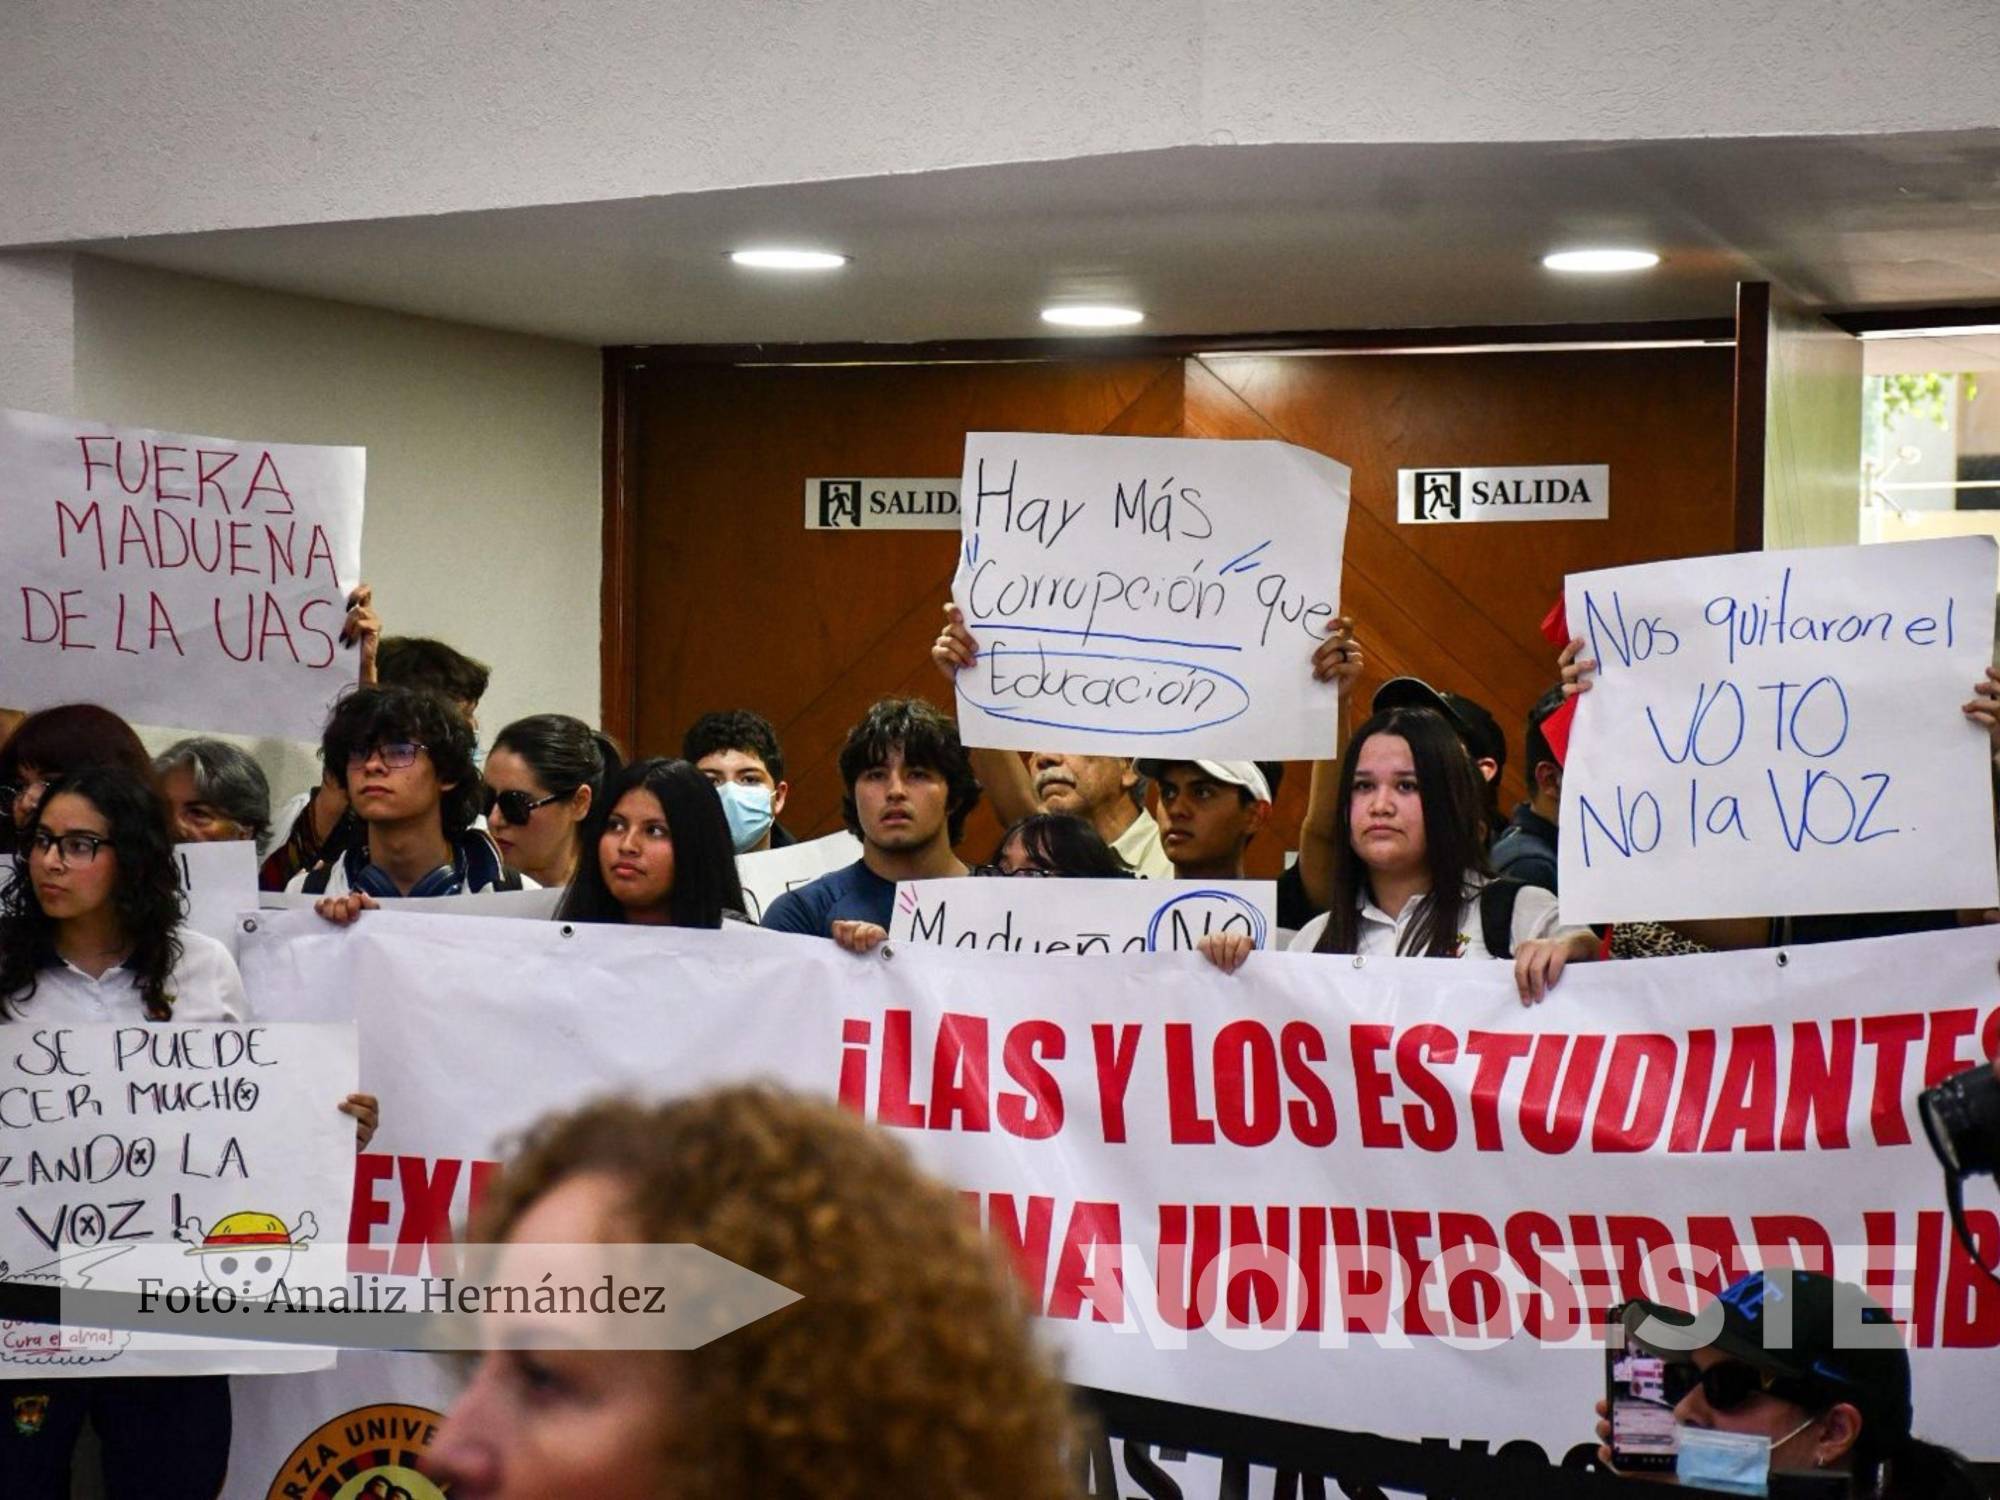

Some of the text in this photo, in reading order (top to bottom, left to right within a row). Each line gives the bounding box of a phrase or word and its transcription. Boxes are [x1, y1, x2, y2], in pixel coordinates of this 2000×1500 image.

[76, 436, 294, 514] FUERA
[974, 457, 1214, 549] Hay Más
[1471, 477, 1593, 506] SALIDA
[21, 586, 335, 668] DE LA UAS
[1256, 573, 1333, 647] que
[1583, 567, 1954, 675] Nos quitaron el
[990, 640, 1216, 713] Educación
[1645, 674, 1850, 767] VOTO
[1579, 785, 1662, 868] NO
[1690, 778, 1752, 848] la
[14, 1026, 278, 1076] SE PUEDE
[1091, 1023, 1143, 1144] Y
[1164, 1019, 1338, 1148] LOS
[1350, 1006, 2000, 1156] ESTUDIANTE
[128, 1076, 260, 1115] MUCHO
[180, 1132, 250, 1179] LA
[957, 1191, 1125, 1324] NA
